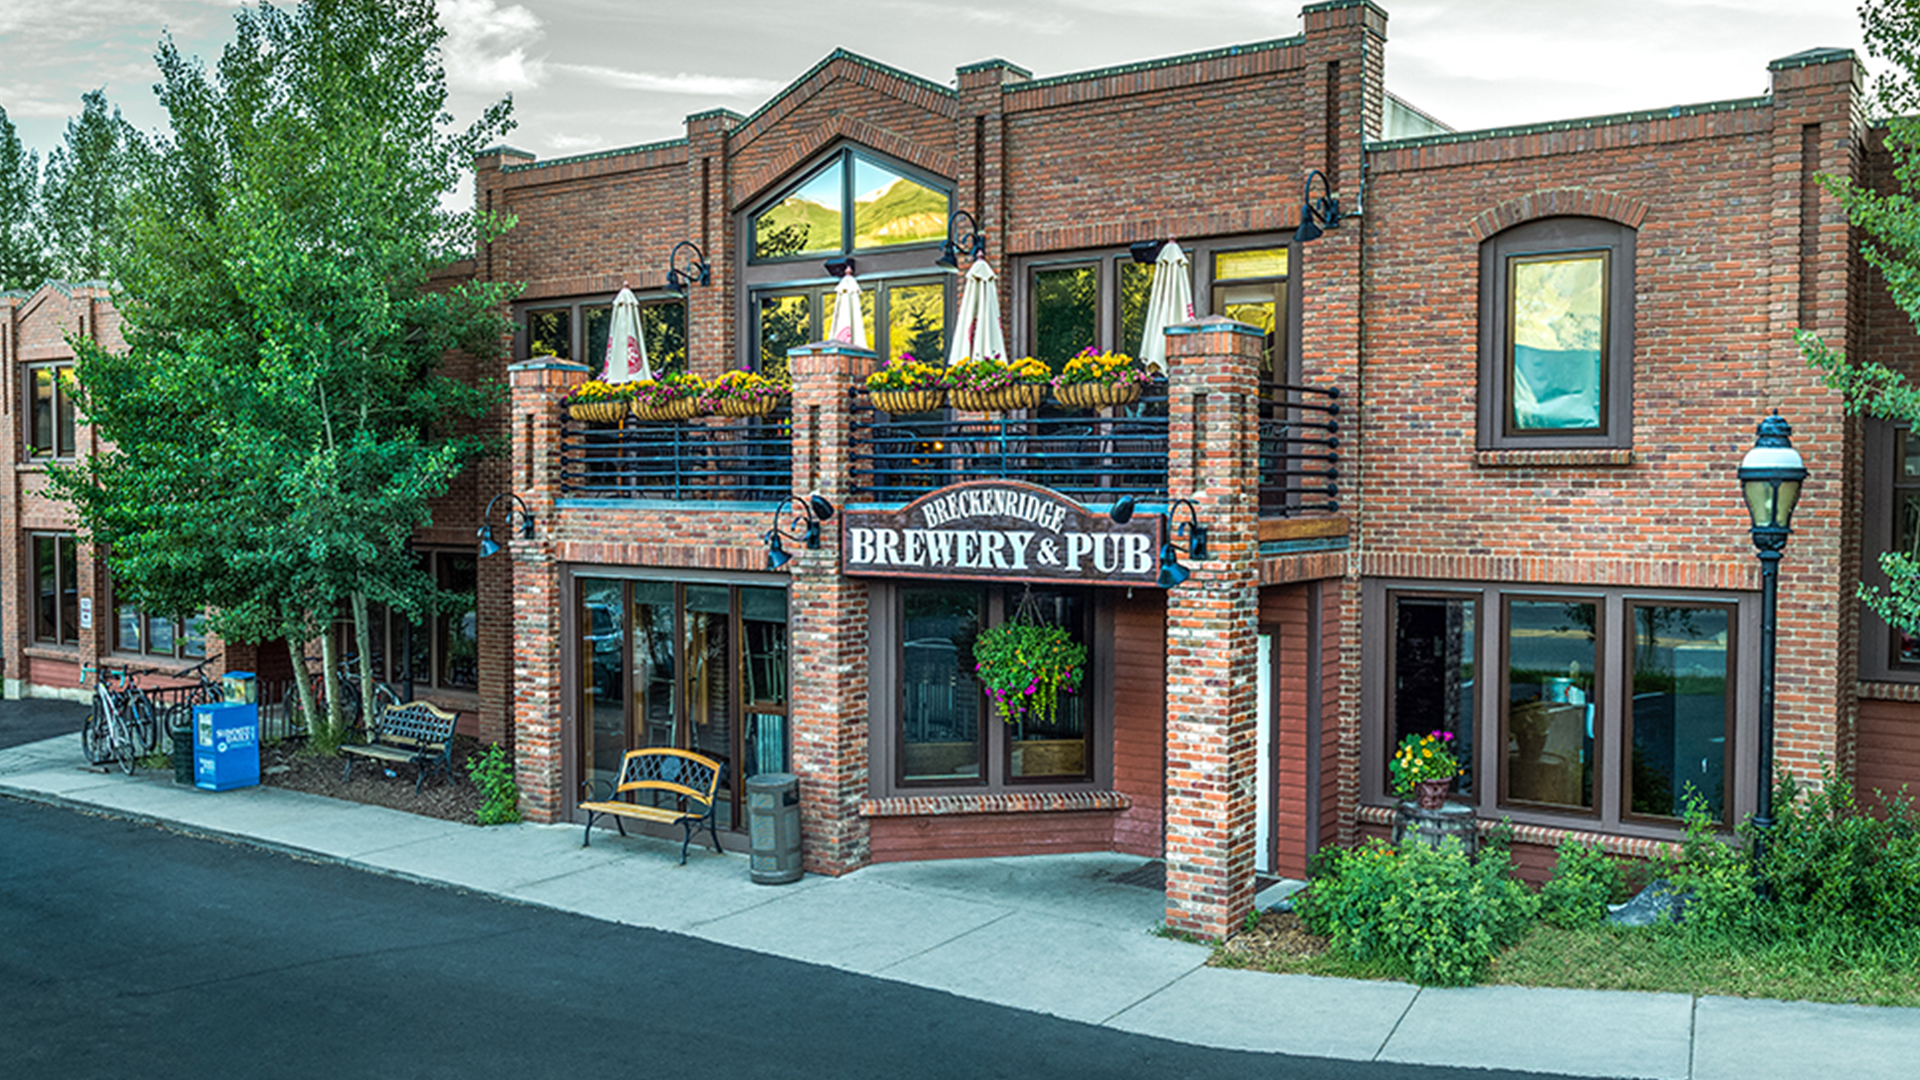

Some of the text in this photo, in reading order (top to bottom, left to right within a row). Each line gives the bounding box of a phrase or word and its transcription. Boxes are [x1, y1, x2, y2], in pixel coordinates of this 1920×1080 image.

[922, 489, 1066, 533] BRECKENRIDGE
[850, 528, 1152, 574] BREWERY & PUB
